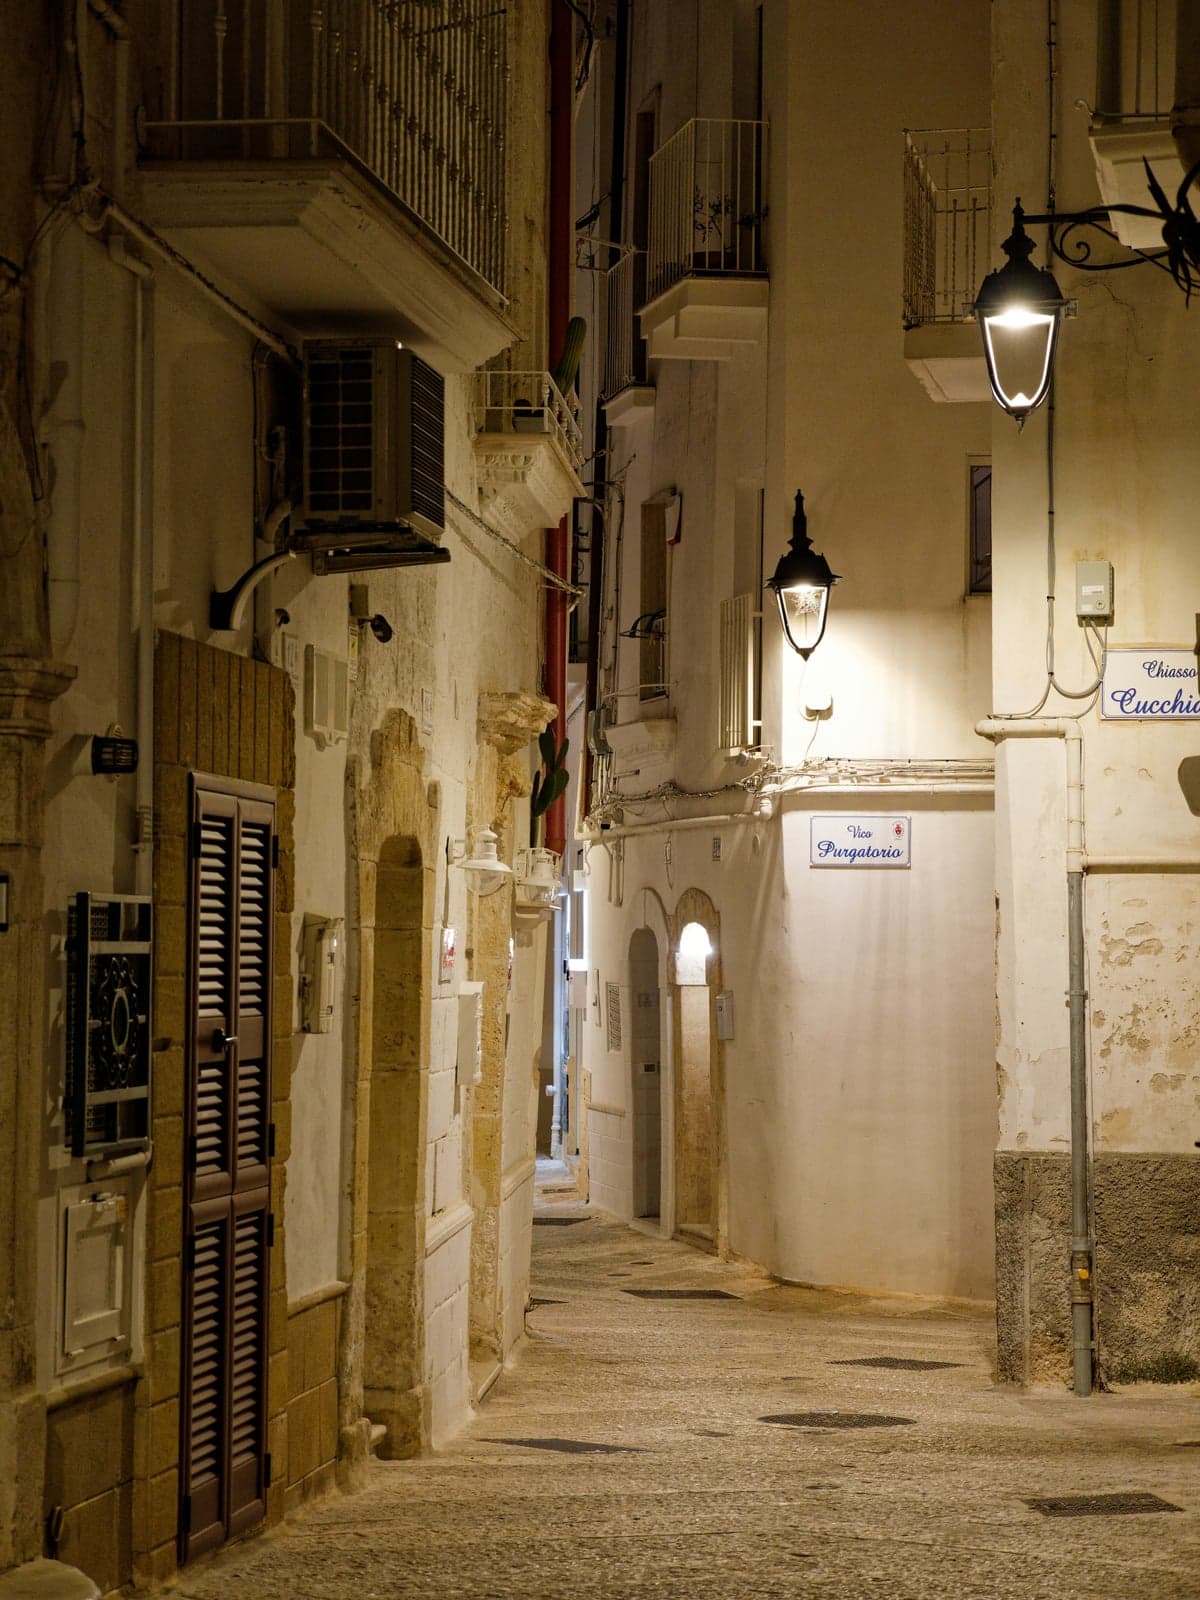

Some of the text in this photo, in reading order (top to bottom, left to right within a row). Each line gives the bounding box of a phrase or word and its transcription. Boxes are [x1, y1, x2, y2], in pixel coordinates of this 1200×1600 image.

[1142, 660, 1198, 678] Chiasso
[847, 825, 873, 838] Vico
[817, 840, 903, 863] Purgatorio
